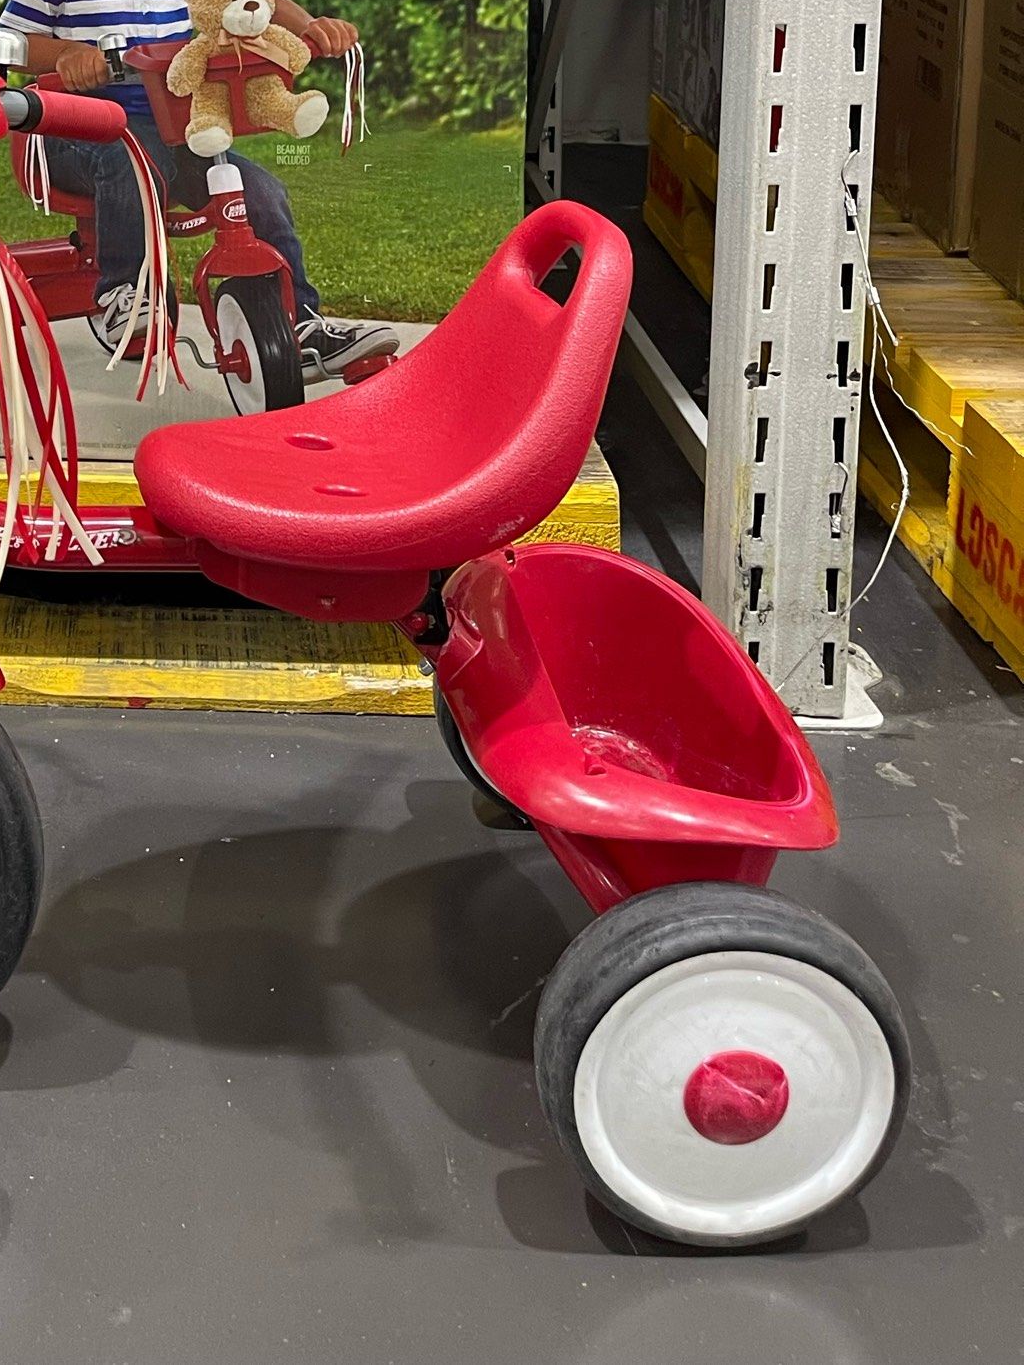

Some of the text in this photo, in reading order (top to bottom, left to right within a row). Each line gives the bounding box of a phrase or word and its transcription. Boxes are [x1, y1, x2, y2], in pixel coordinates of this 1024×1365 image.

[276, 144, 311, 155] BEAR NOT
[276, 155, 310, 166] INCLUDED
